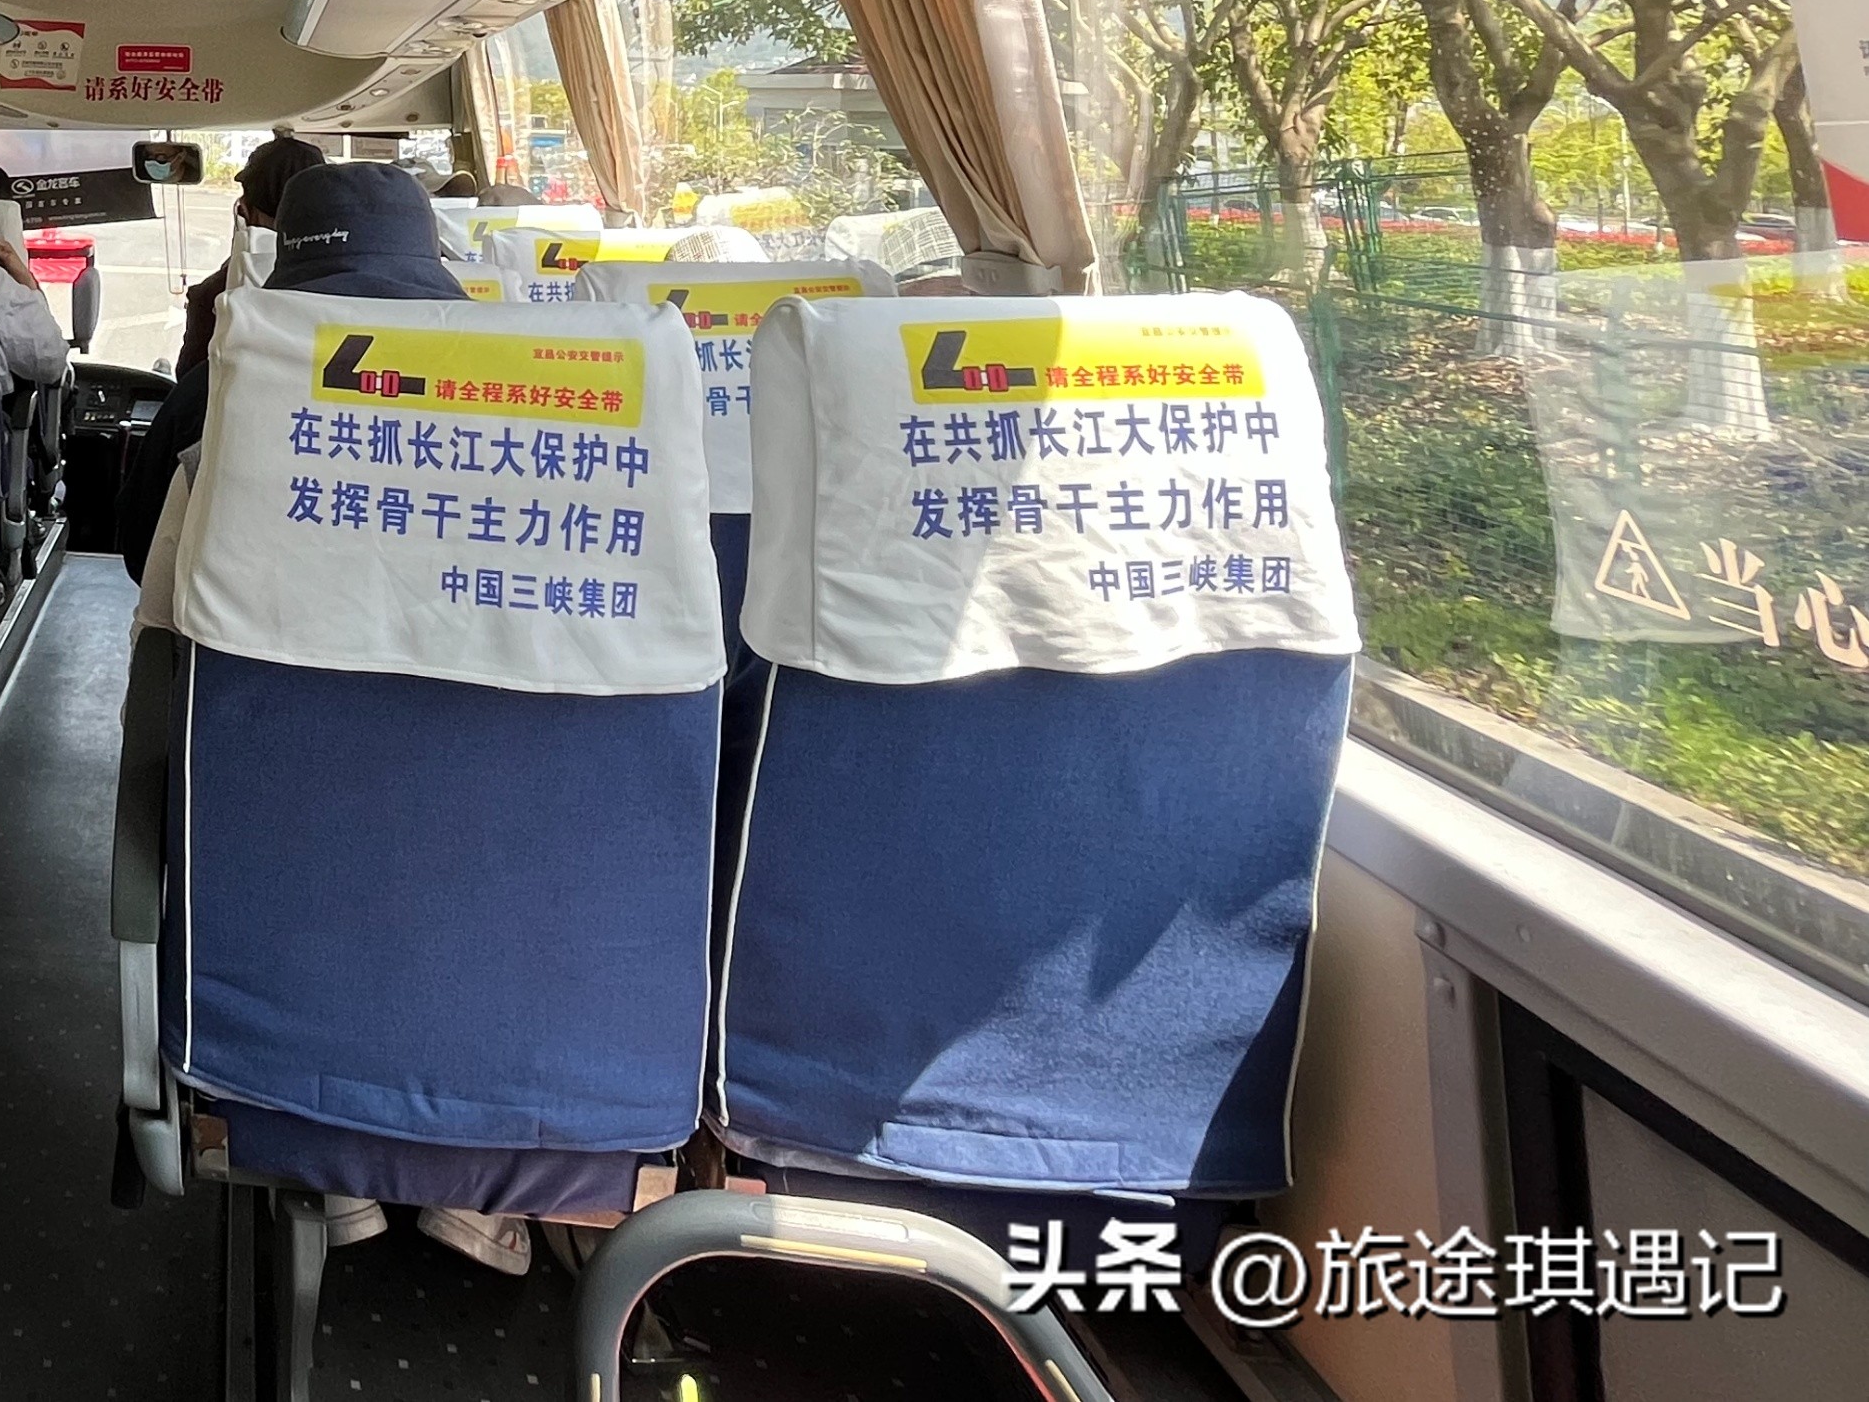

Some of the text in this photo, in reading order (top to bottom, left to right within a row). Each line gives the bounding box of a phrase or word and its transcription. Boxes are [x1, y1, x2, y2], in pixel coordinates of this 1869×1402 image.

[84, 75, 224, 104] 请系好安全带
[533, 348, 623, 363] 宜昌公安交警提示
[695, 339, 752, 372] 抓长
[1046, 363, 1245, 387] 请全程系好安全带
[435, 378, 623, 412] 请全程系好安全带
[289, 409, 651, 491] 在共抓长江大保护中
[900, 401, 1280, 466] 在共抓长江大保护中
[287, 476, 646, 557] 发挥骨干主力作用
[911, 479, 1290, 539] 发挥骨干主力作用
[440, 566, 639, 620] 中国三峡集团
[1089, 556, 1291, 603] 中国三峡集团
